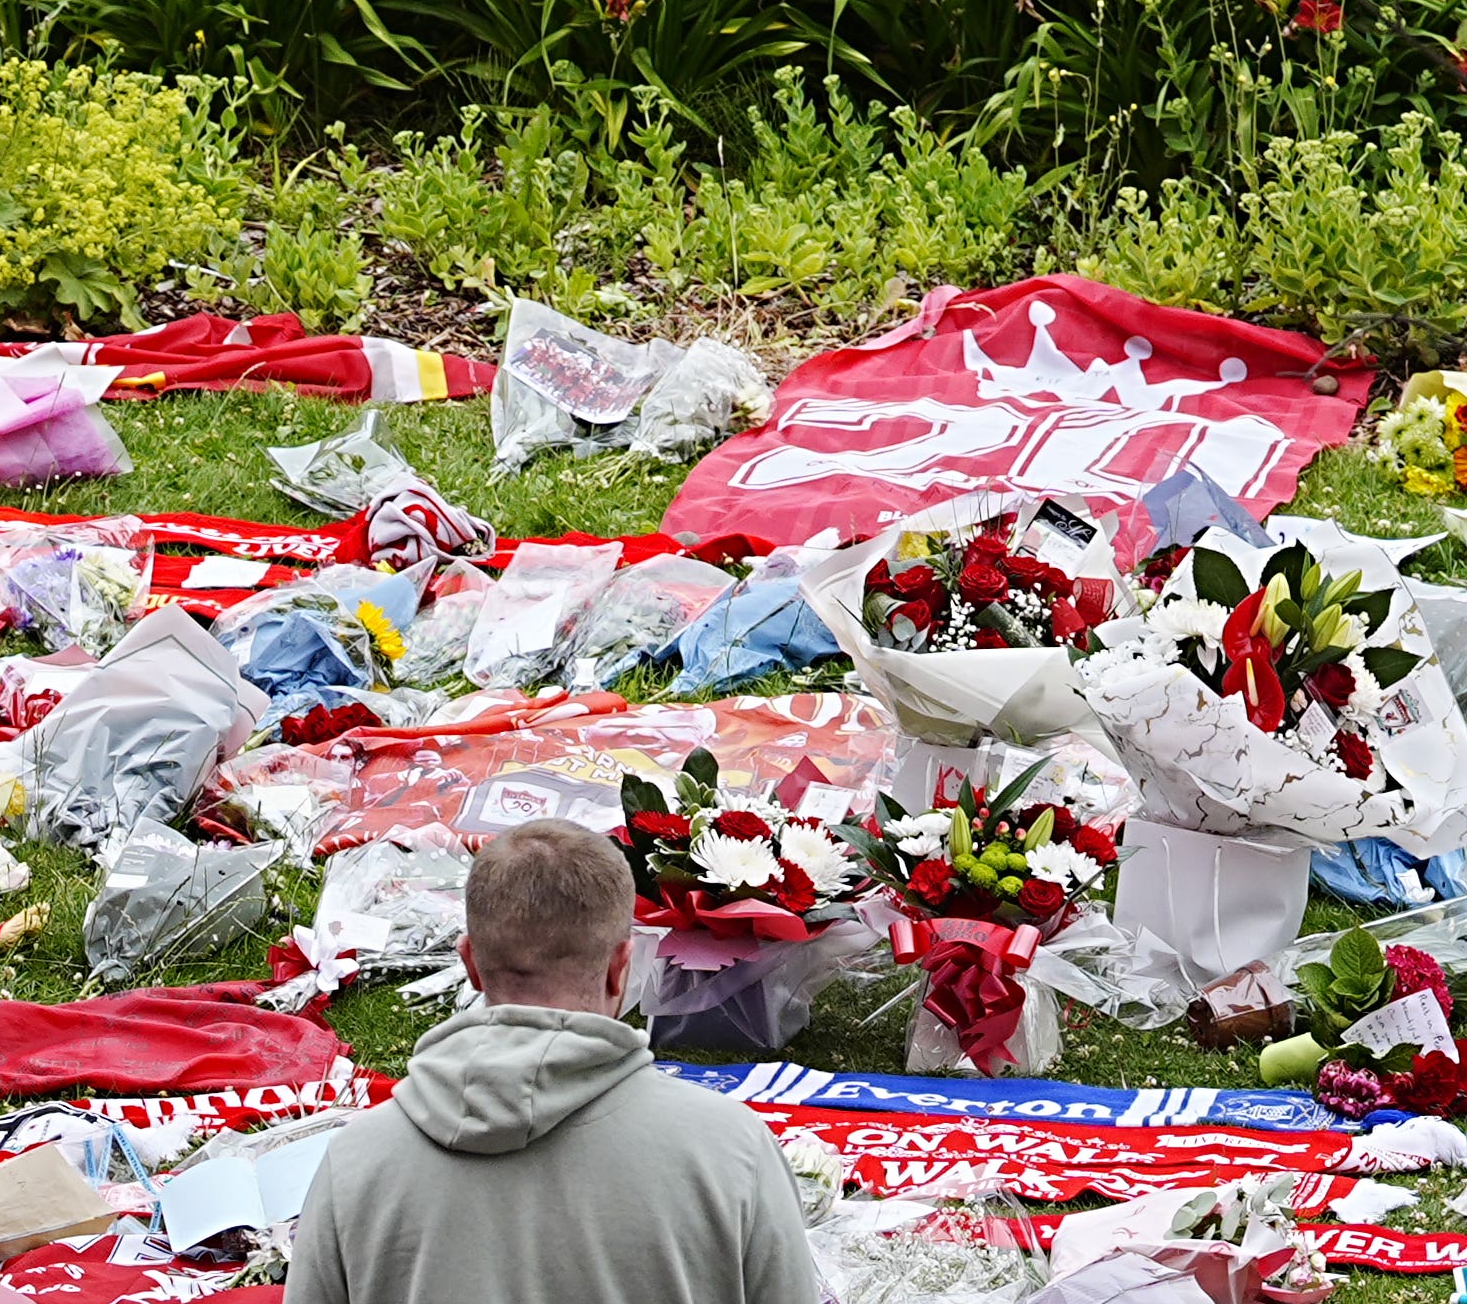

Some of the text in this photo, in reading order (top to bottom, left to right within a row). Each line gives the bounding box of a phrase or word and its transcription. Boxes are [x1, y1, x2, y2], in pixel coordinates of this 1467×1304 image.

[827, 1078, 1110, 1120] Everton
[885, 1157, 1065, 1199] WALK
[1304, 1227, 1414, 1261] VER
